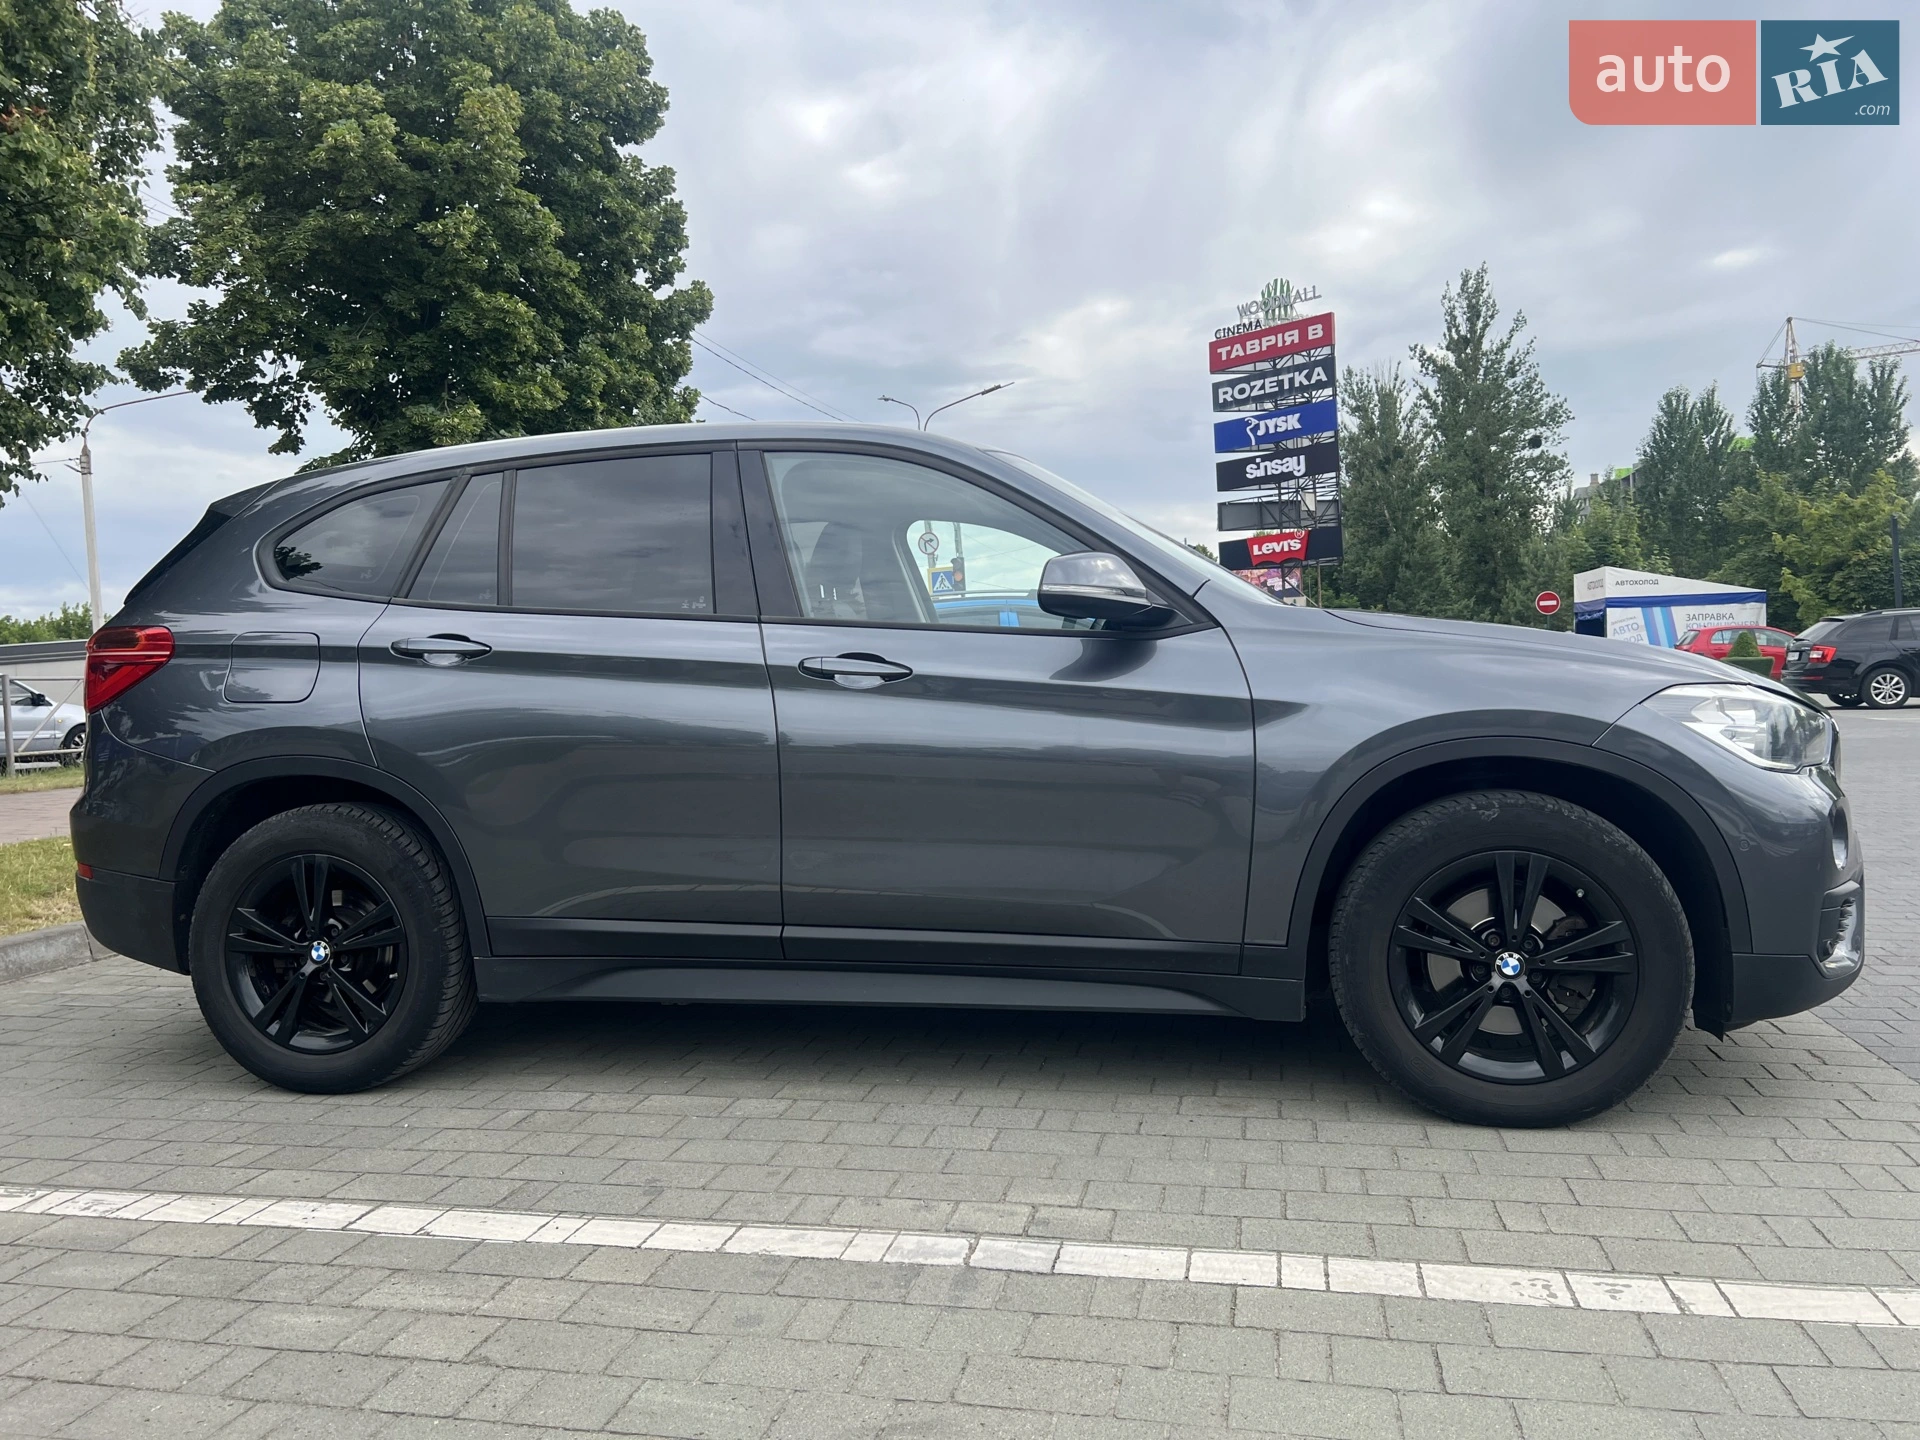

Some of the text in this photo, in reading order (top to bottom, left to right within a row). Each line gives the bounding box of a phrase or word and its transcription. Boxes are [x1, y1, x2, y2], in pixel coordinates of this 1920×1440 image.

[1214, 318, 1263, 340] CINEMA
[1216, 323, 1324, 361] ТАВРІЯ В
[1218, 366, 1328, 404] ROZETKA
[1256, 412, 1303, 436] JYSK
[1245, 455, 1306, 479] sinsay
[1612, 621, 1640, 637] АВТО
[1685, 612, 1735, 622] ЗАПРАВКА
